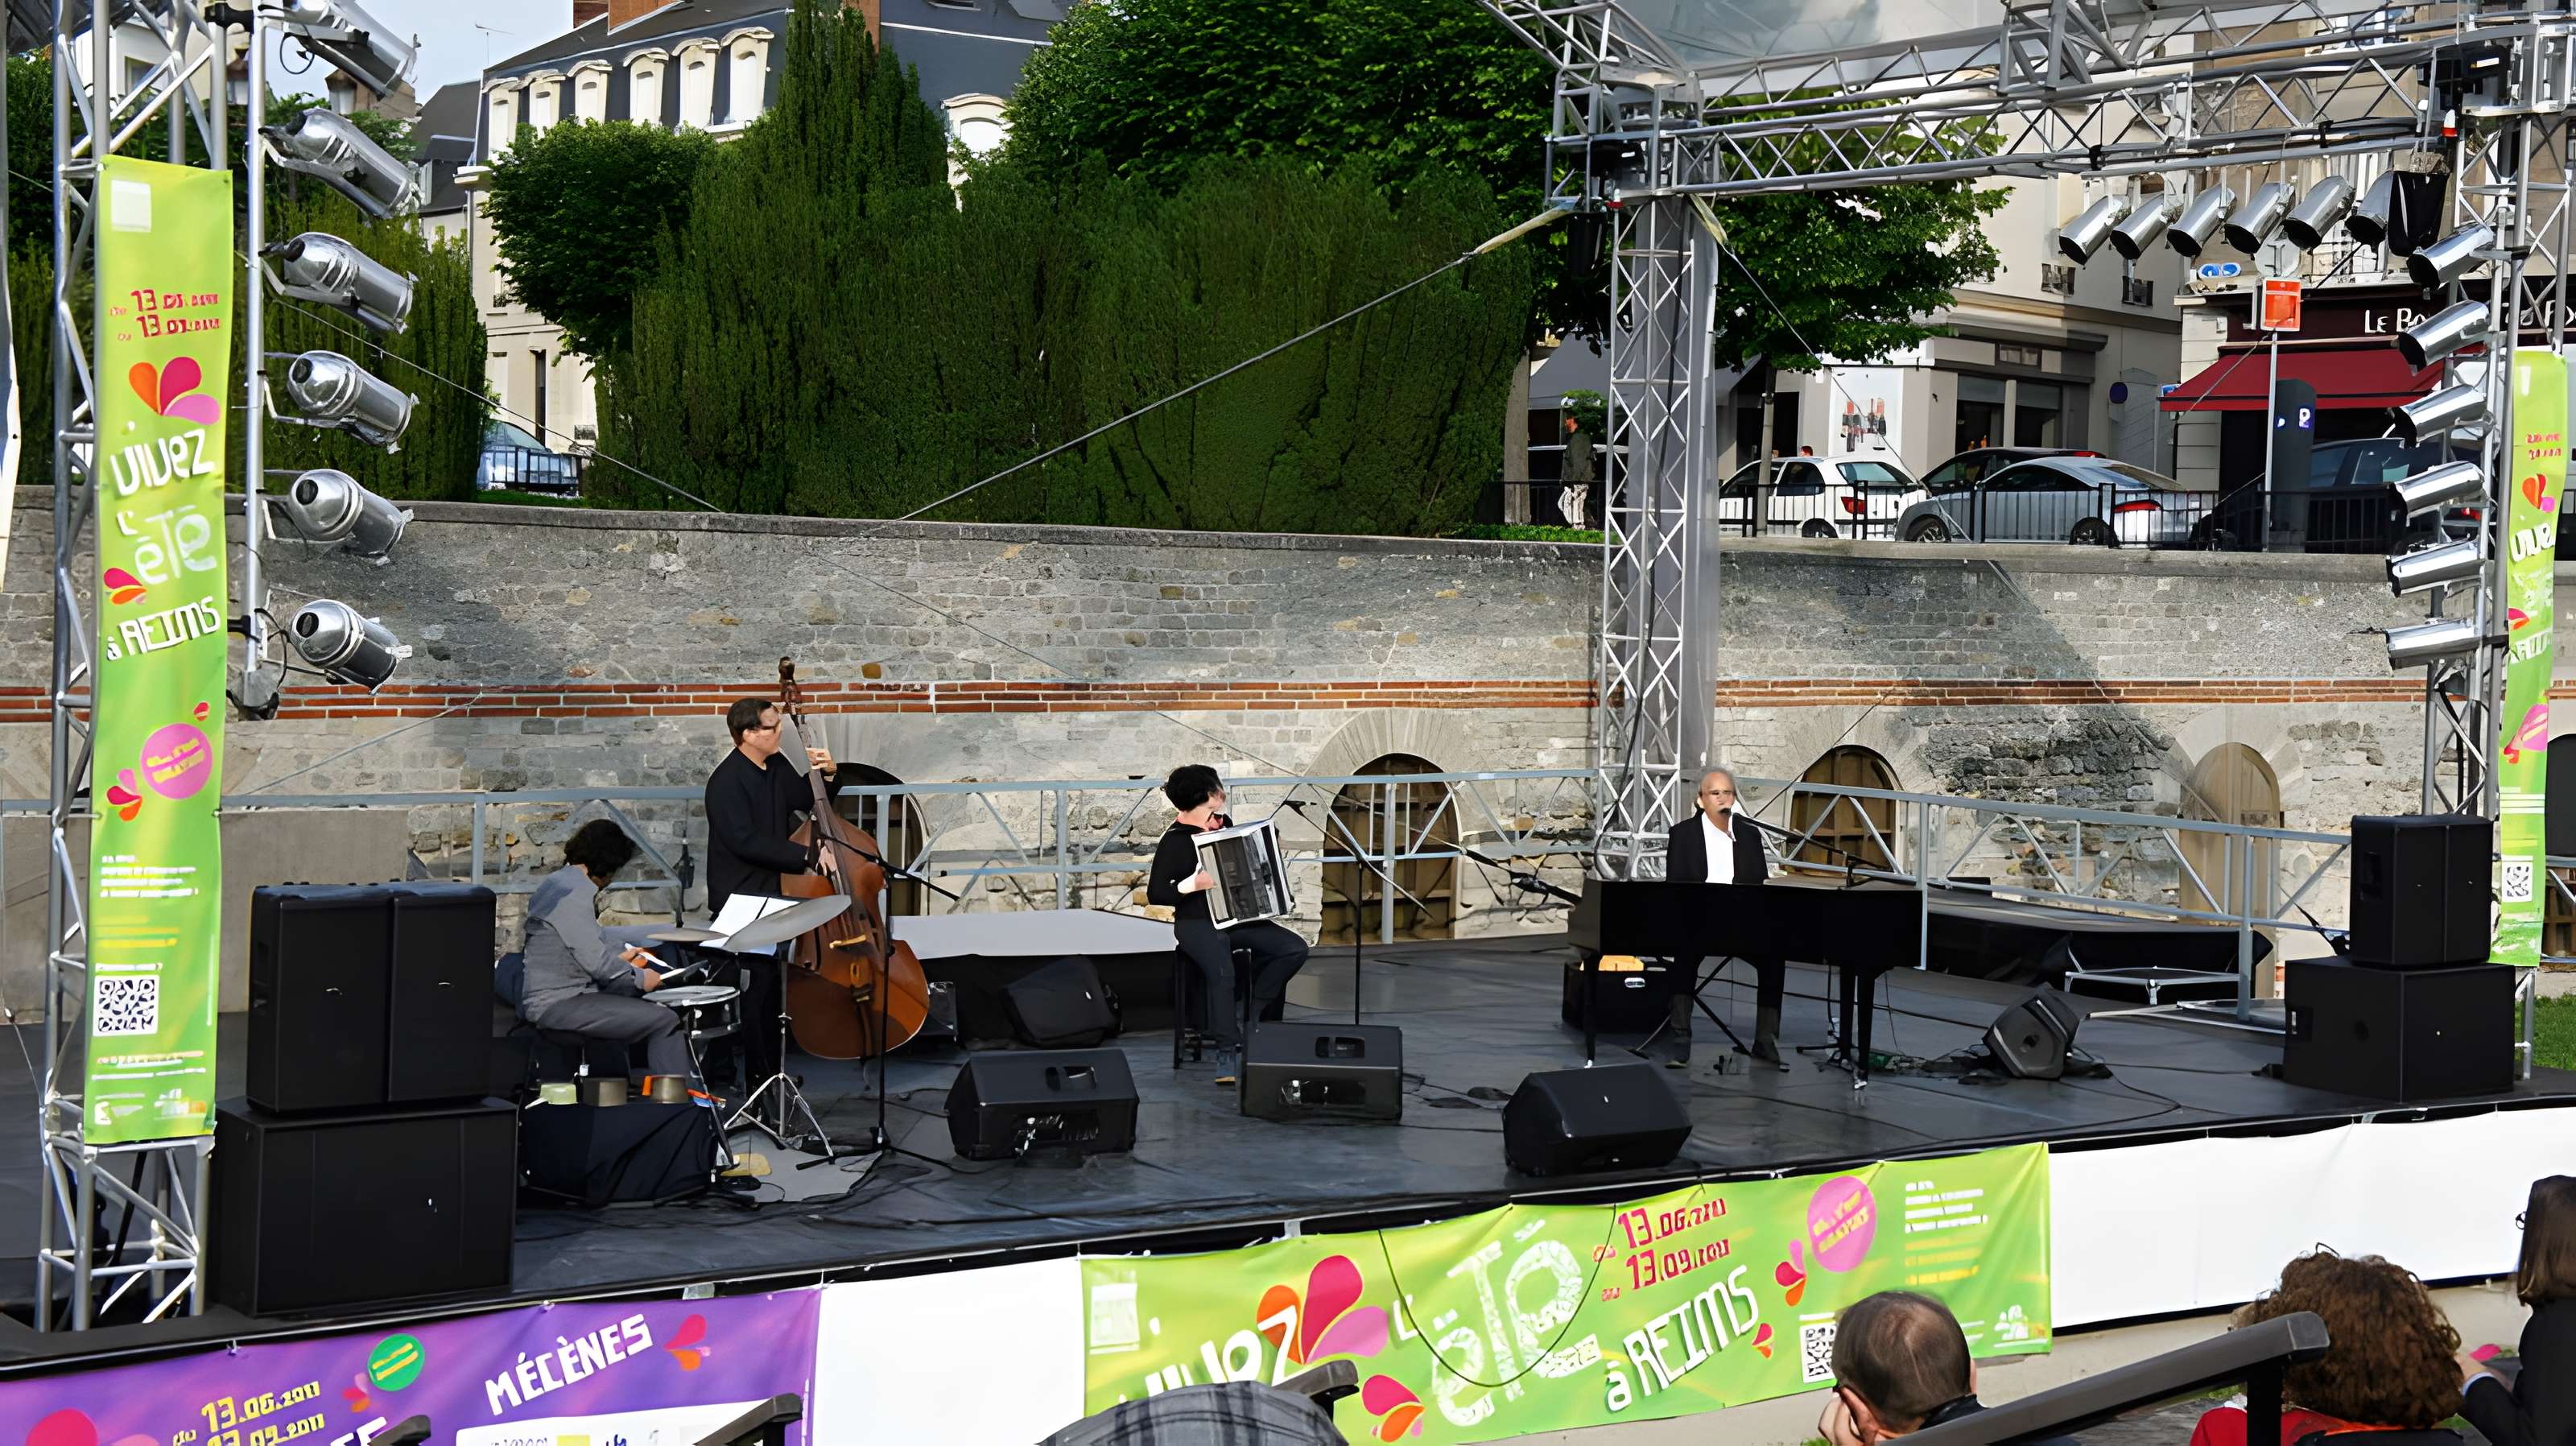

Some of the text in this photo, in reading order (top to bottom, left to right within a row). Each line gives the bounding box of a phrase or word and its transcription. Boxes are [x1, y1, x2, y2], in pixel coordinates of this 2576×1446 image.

[485, 1313, 654, 1416] MÉCÈNES
[1604, 1264, 1759, 1411] à REIMS
